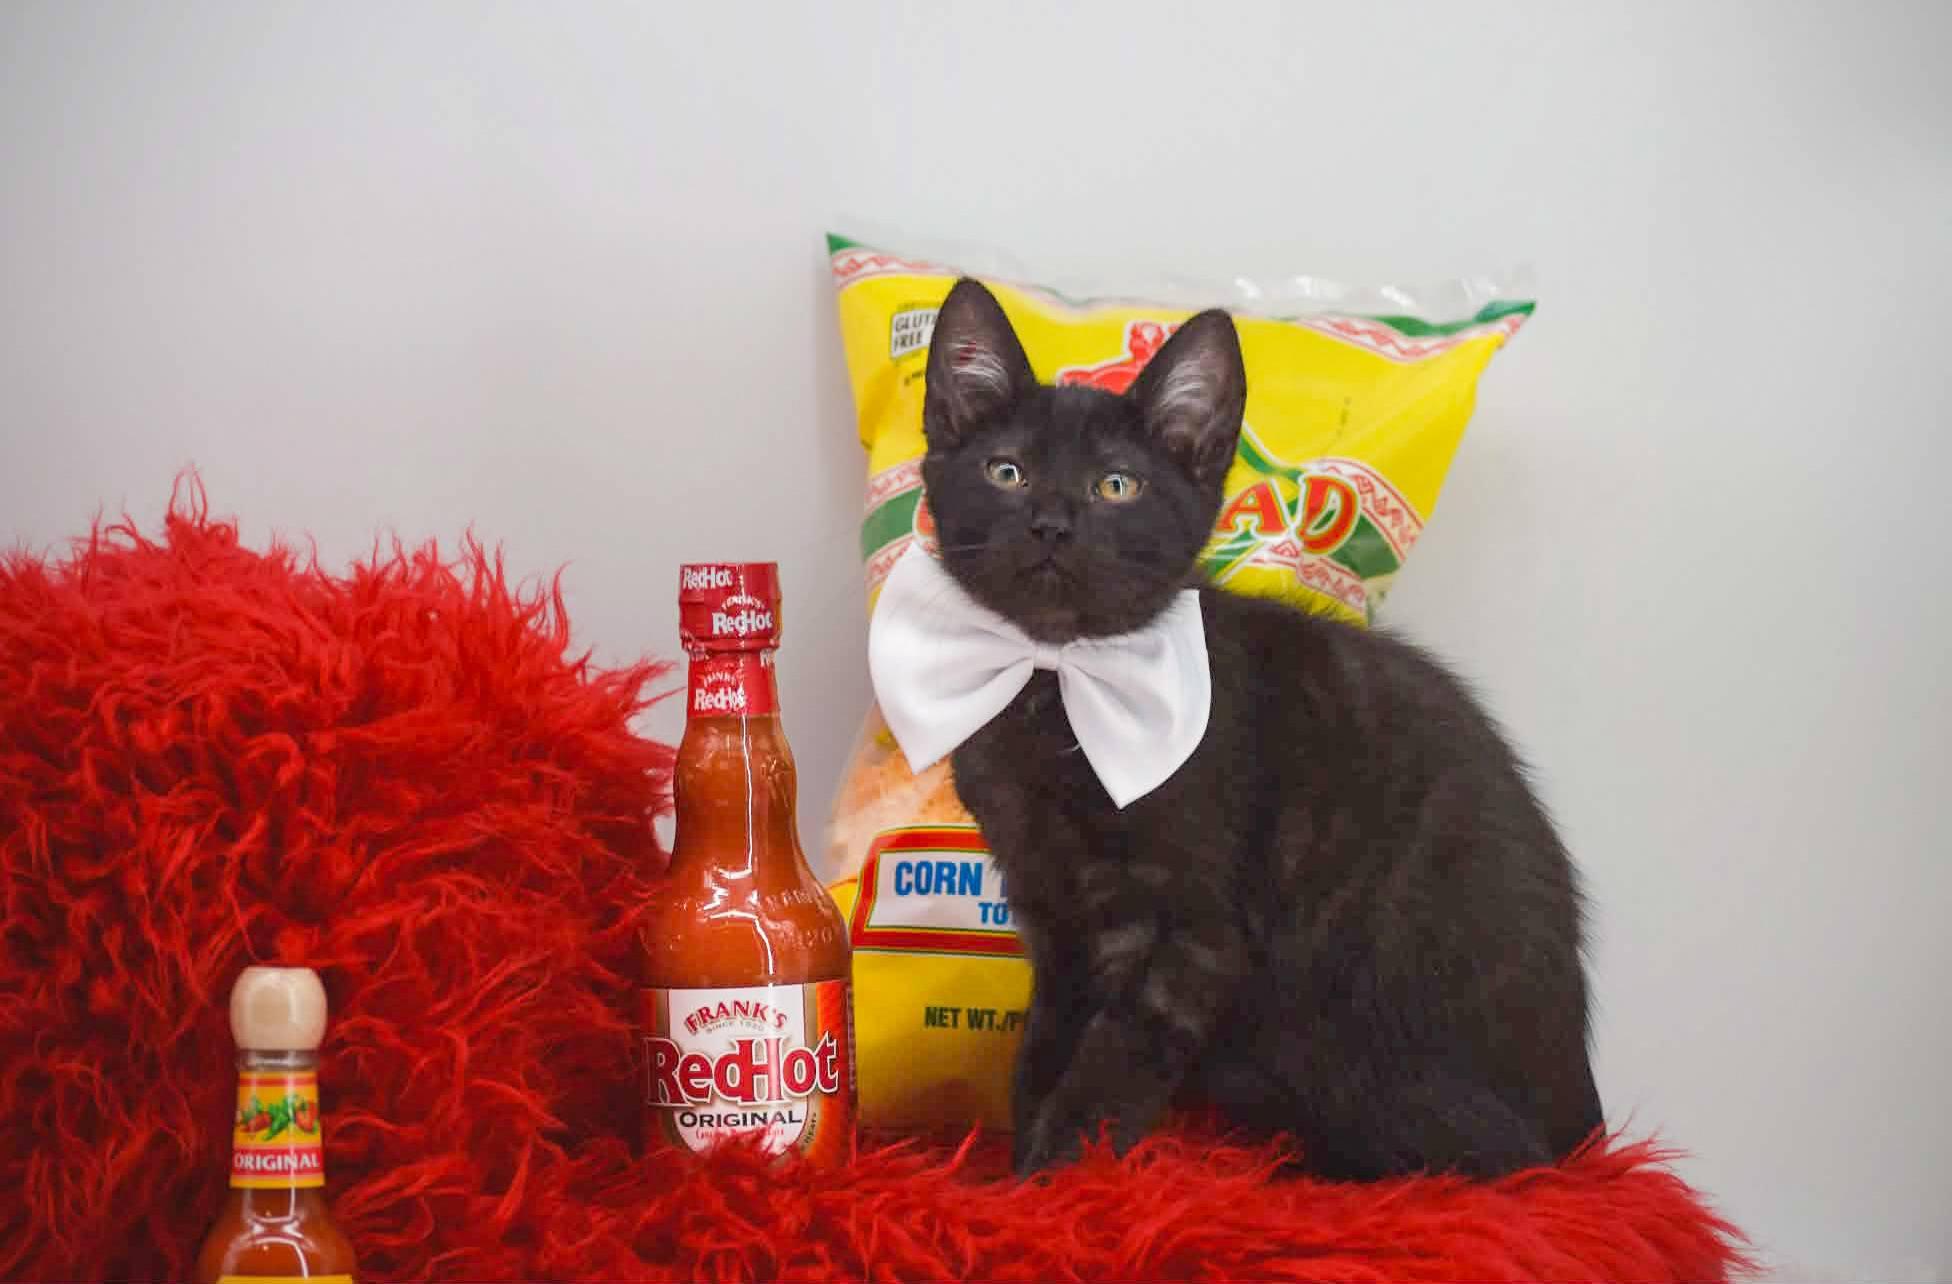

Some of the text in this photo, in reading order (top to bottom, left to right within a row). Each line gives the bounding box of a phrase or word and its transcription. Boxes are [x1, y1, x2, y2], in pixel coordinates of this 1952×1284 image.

[892, 331, 922, 353] FREE
[682, 566, 733, 590] RedHot
[711, 609, 774, 636] RedHot
[694, 685, 747, 711] RedHot
[894, 860, 984, 897] CORN
[977, 902, 1016, 926] TO
[684, 999, 788, 1036] FRANK'S
[925, 1006, 961, 1030] NET
[645, 1031, 840, 1108] RedHot
[679, 1111, 803, 1129] ORIGINAL
[233, 1152, 321, 1170] ORIGINAL
